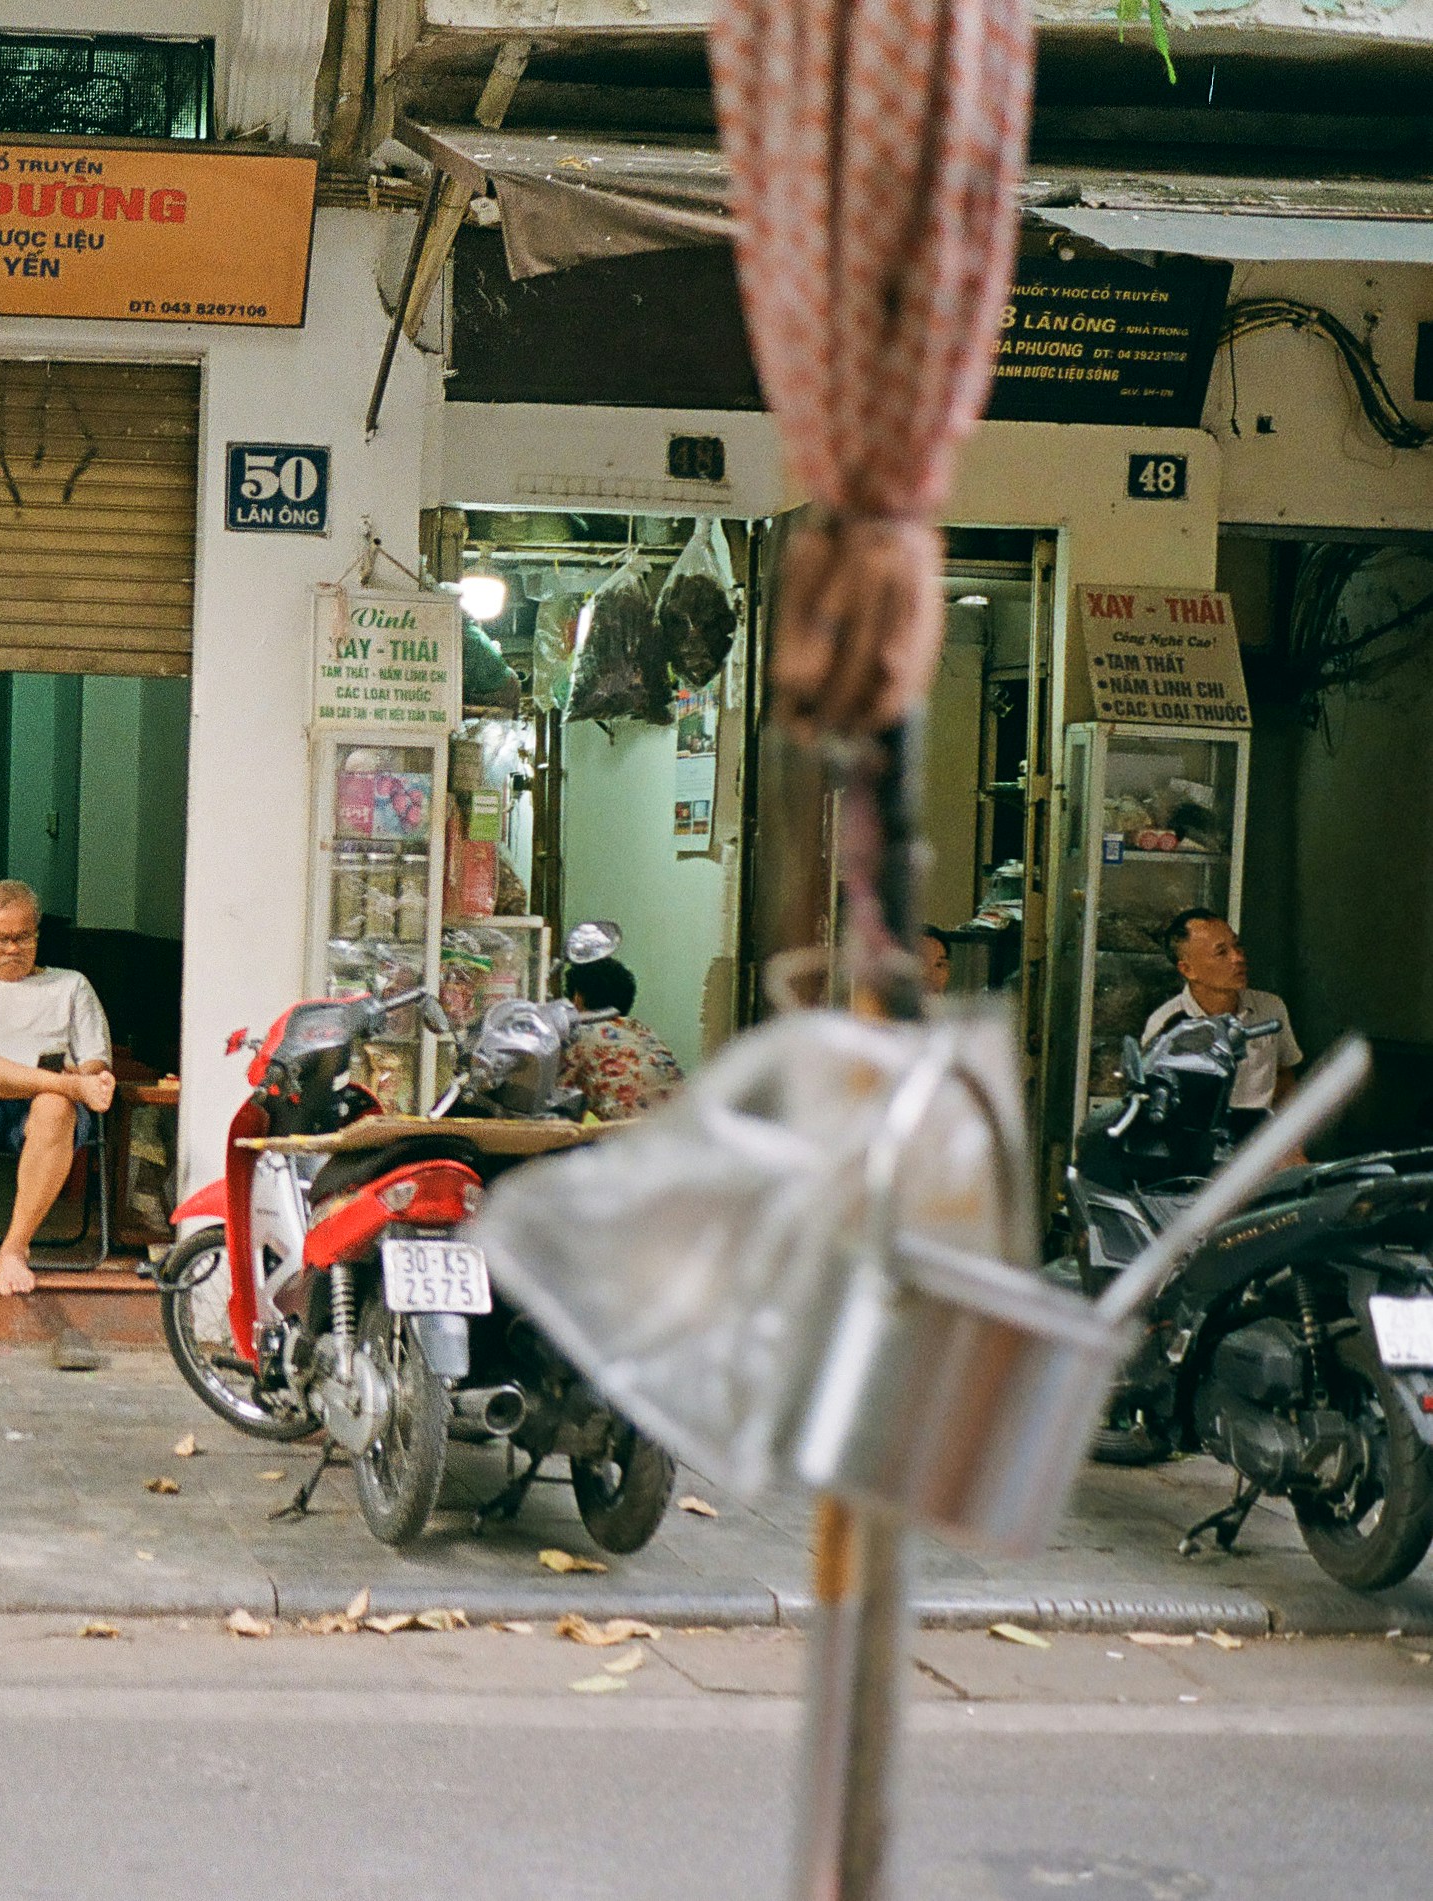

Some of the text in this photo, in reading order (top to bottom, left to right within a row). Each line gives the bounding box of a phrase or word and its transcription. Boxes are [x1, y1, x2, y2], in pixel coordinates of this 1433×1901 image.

[54, 229, 105, 254] LIỆU
[3, 249, 60, 278] YẾN
[1009, 282, 1047, 297] HUỐC
[161, 301, 191, 315] 043
[998, 305, 1017, 328] 8
[1024, 311, 1068, 331] LÃN
[1071, 313, 1117, 333] ÔNG
[240, 452, 319, 502] 50
[1138, 460, 1176, 493] 48
[237, 504, 319, 524] LÃN ÔNG
[351, 608, 417, 630] Vinh
[1087, 592, 1135, 619] XAY
[1164, 595, 1226, 625] THÁI
[389, 636, 439, 662] THÁI
[1153, 679, 1192, 698] LINH
[1196, 681, 1225, 699] CHI
